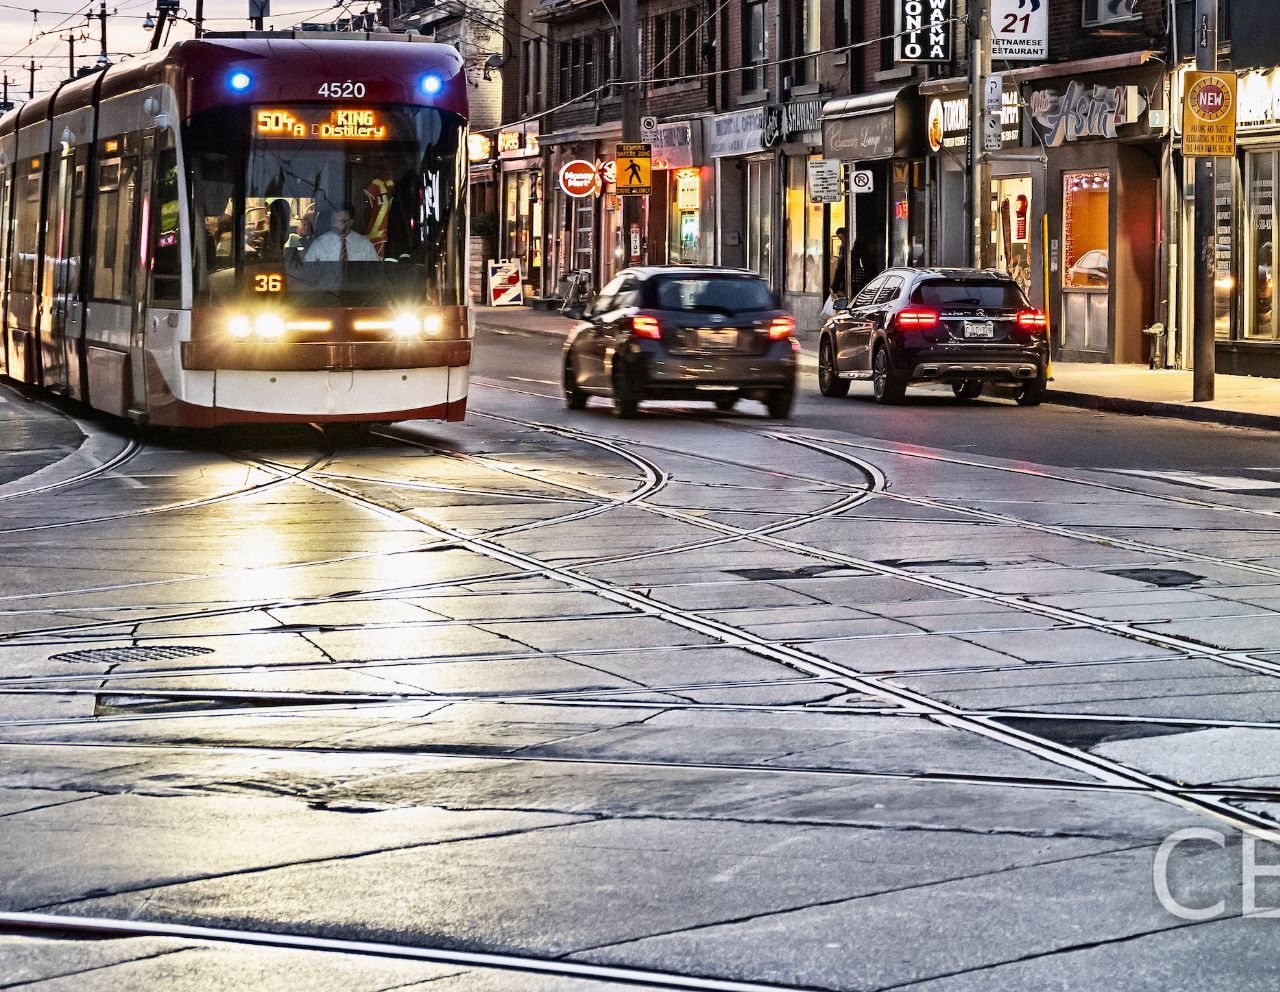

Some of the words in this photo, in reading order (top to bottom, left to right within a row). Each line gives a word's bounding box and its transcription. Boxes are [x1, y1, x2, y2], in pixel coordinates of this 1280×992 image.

[1000, 13, 1031, 34] 21
[991, 38, 1043, 46] IETNAMESE
[991, 47, 1045, 55] ESTAURANT
[317, 82, 365, 98] 4520
[1200, 92, 1222, 106] NEW
[337, 111, 374, 125] KING
[943, 98, 969, 131] TORONT
[1045, 80, 1118, 147] Asia
[321, 124, 384, 137] Distillery
[564, 171, 595, 180] Money
[255, 274, 282, 292] 36
